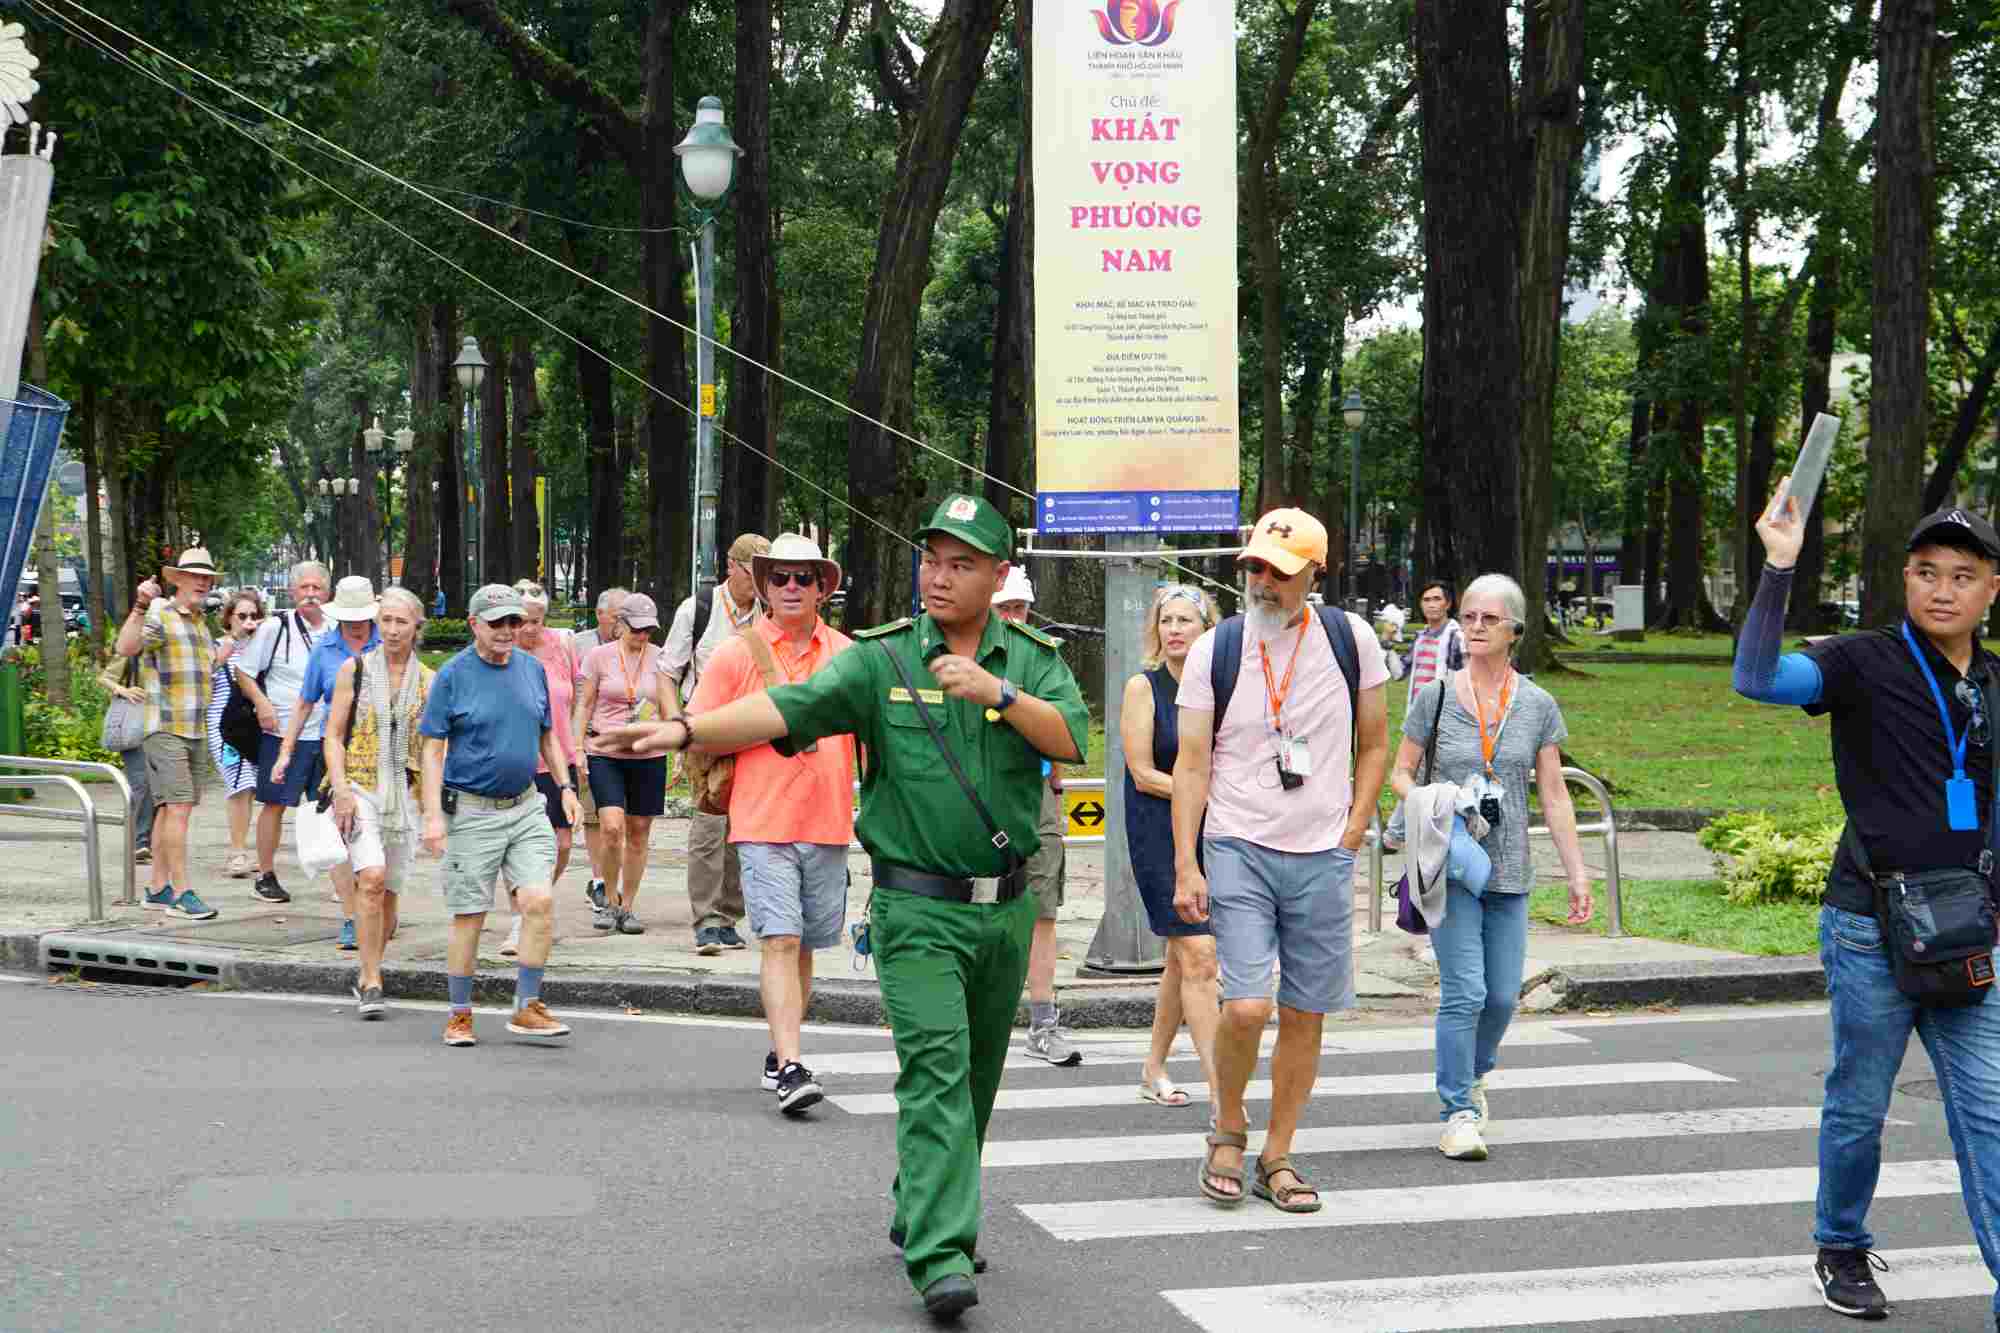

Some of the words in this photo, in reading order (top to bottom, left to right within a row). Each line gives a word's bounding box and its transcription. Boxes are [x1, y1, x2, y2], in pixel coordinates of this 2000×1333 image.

[1091, 112, 1181, 141] KHÁT
[1091, 161, 1181, 190] VỌNG
[1071, 200, 1201, 228] PHƯƠNG
[1101, 249, 1172, 273] NAM
